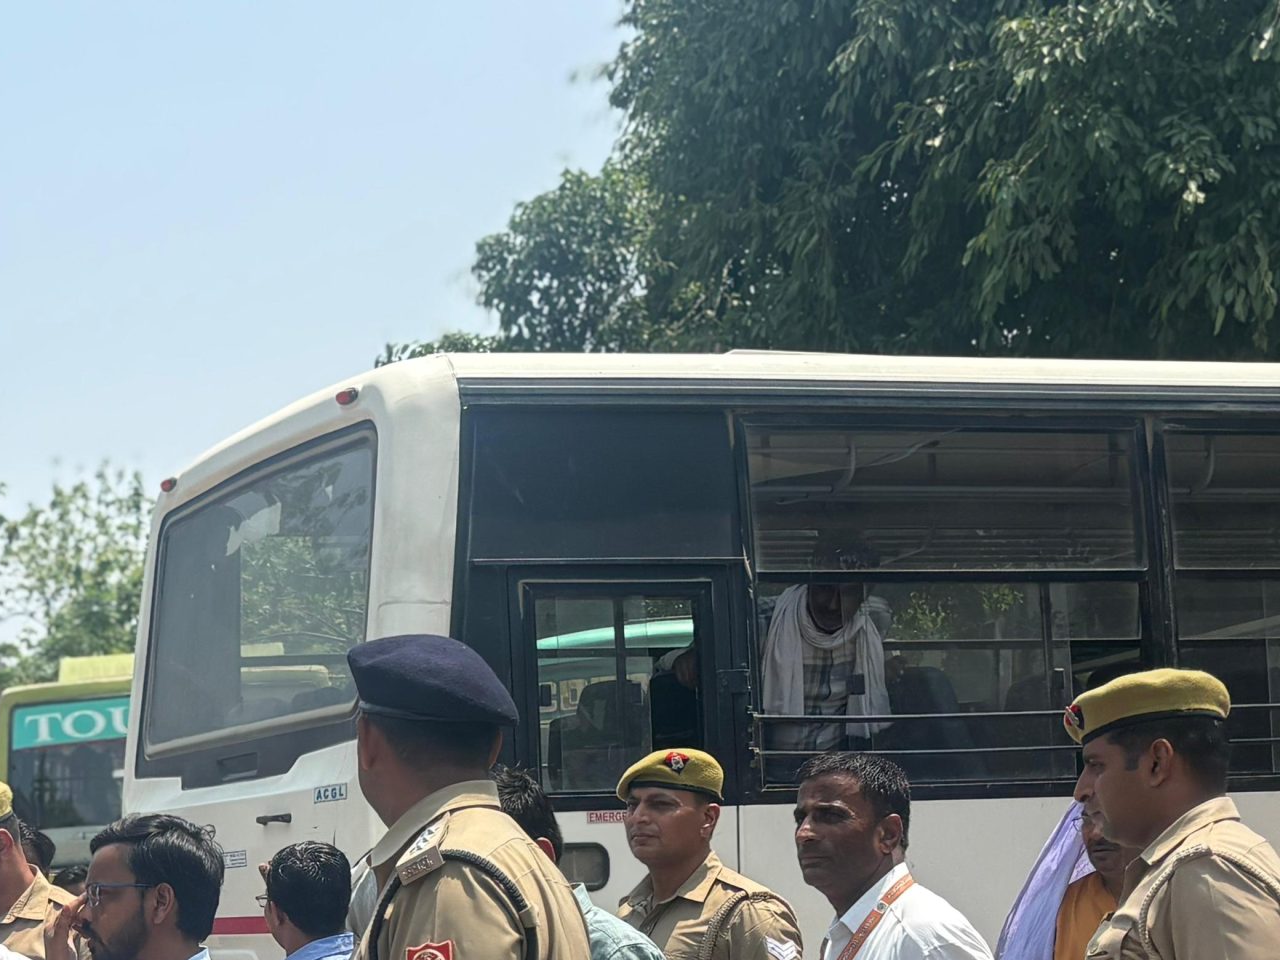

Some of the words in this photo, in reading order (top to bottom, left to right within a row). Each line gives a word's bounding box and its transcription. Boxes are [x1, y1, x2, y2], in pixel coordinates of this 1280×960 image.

[25, 706, 129, 742] TOU
[316, 784, 344, 801] ACGL
[589, 811, 628, 823] EMERGE
